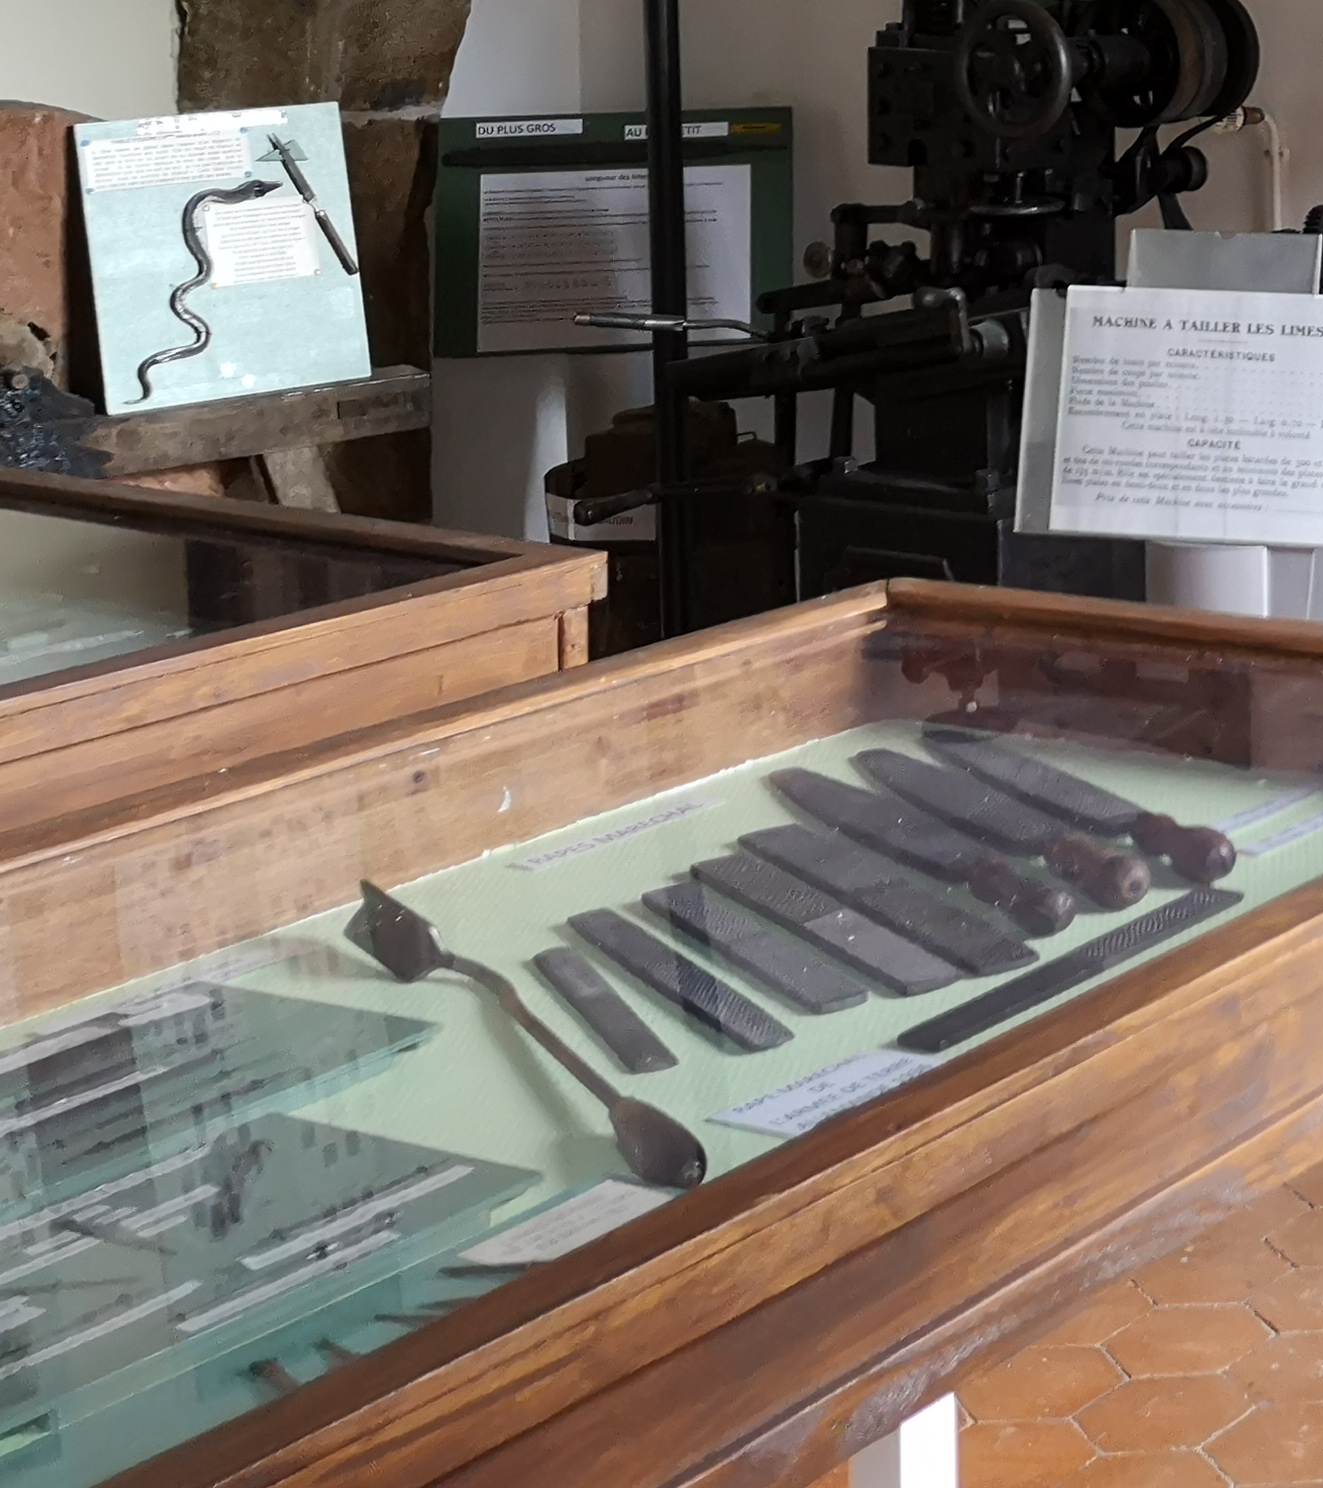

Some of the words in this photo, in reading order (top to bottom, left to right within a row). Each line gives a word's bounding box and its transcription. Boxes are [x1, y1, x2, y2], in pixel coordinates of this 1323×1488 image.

[478, 125, 494, 135] DU
[497, 125, 524, 135] PLUS
[527, 123, 556, 133] GROS
[625, 127, 642, 137] AU
[1092, 316, 1157, 329] MACHINE
[1163, 319, 1173, 330] A
[1179, 320, 1241, 334] TAILLER
[1247, 323, 1275, 335] LES
